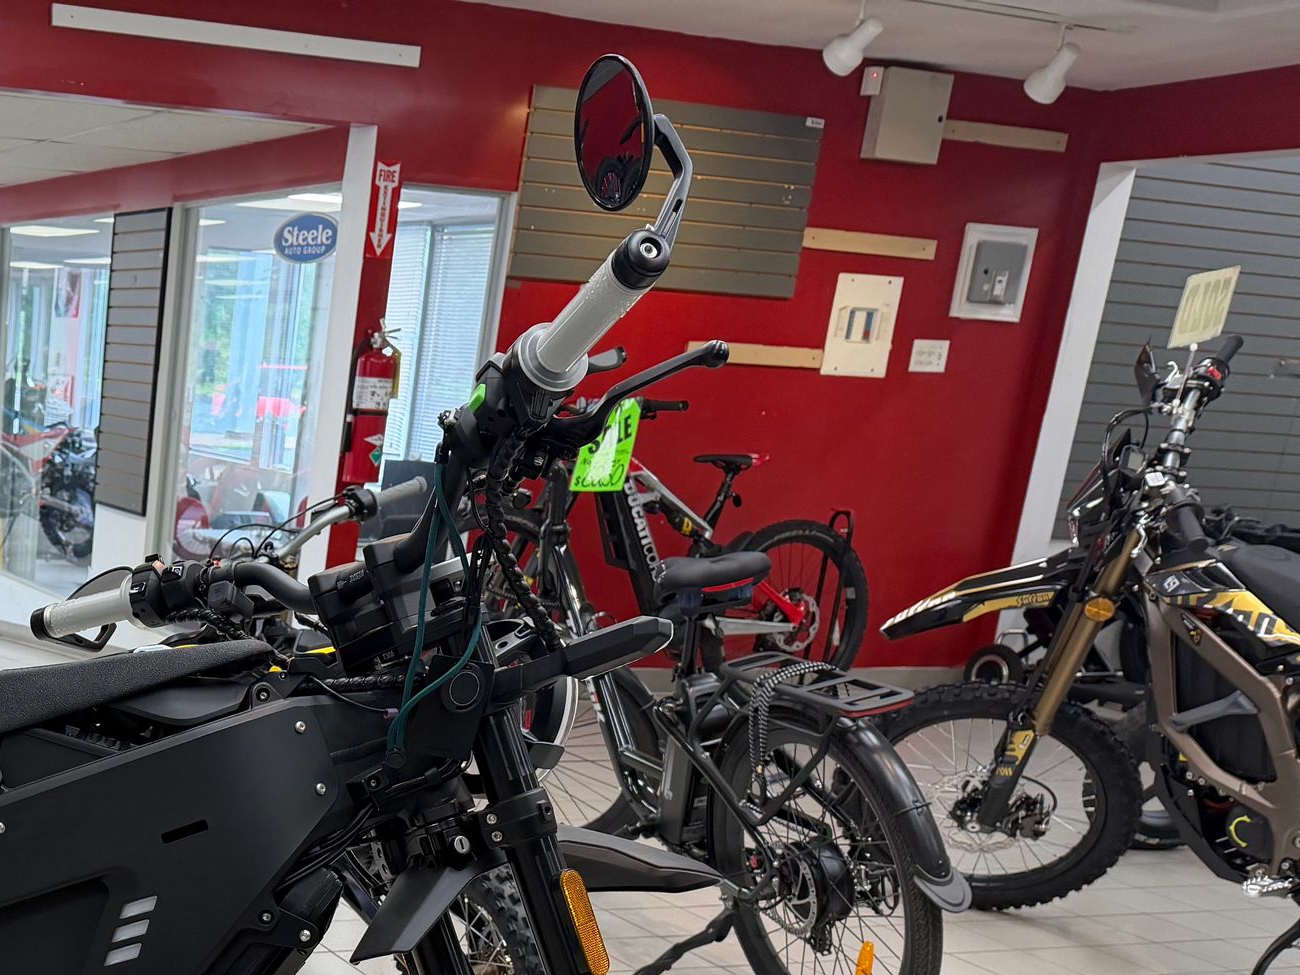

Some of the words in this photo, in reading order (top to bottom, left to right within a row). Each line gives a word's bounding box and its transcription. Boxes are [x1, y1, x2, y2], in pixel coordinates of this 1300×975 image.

[379, 169, 397, 183] FIRE
[282, 225, 332, 246] Steele
[284, 247, 302, 255] AUTO
[302, 246, 326, 255] GROUP
